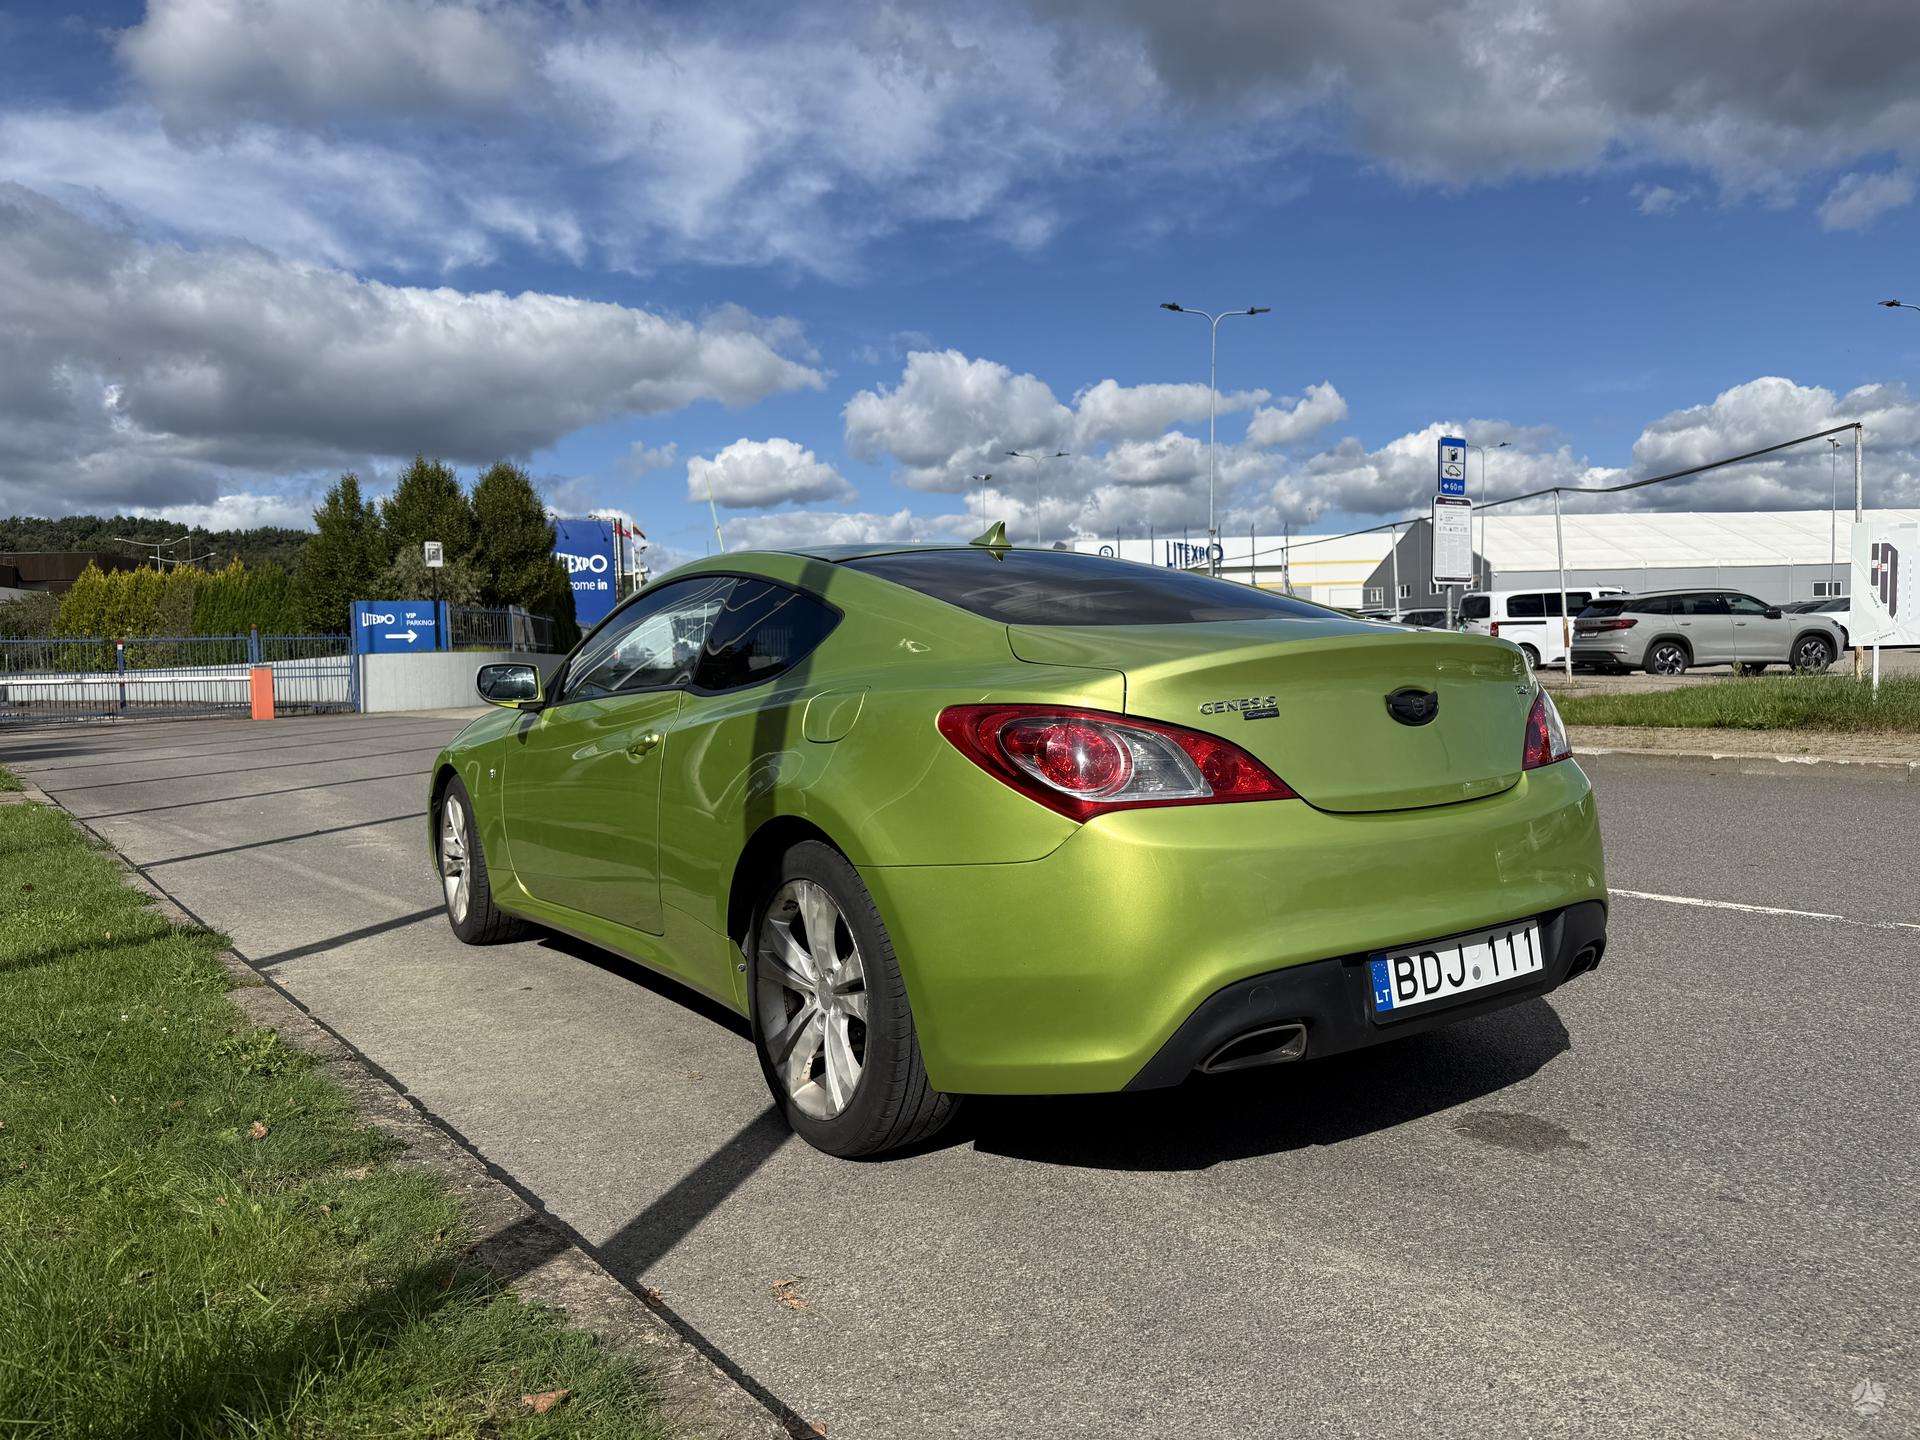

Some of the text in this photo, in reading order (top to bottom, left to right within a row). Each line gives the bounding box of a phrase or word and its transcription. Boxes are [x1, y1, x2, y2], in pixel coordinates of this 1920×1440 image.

[1166, 540, 1224, 569] LITEXPO
[597, 579, 608, 590] in
[362, 612, 395, 627] LITEXPO
[1199, 696, 1277, 715] GENESIS
[1393, 926, 1535, 1002] BDJ 111
[1375, 988, 1390, 1004] LT
